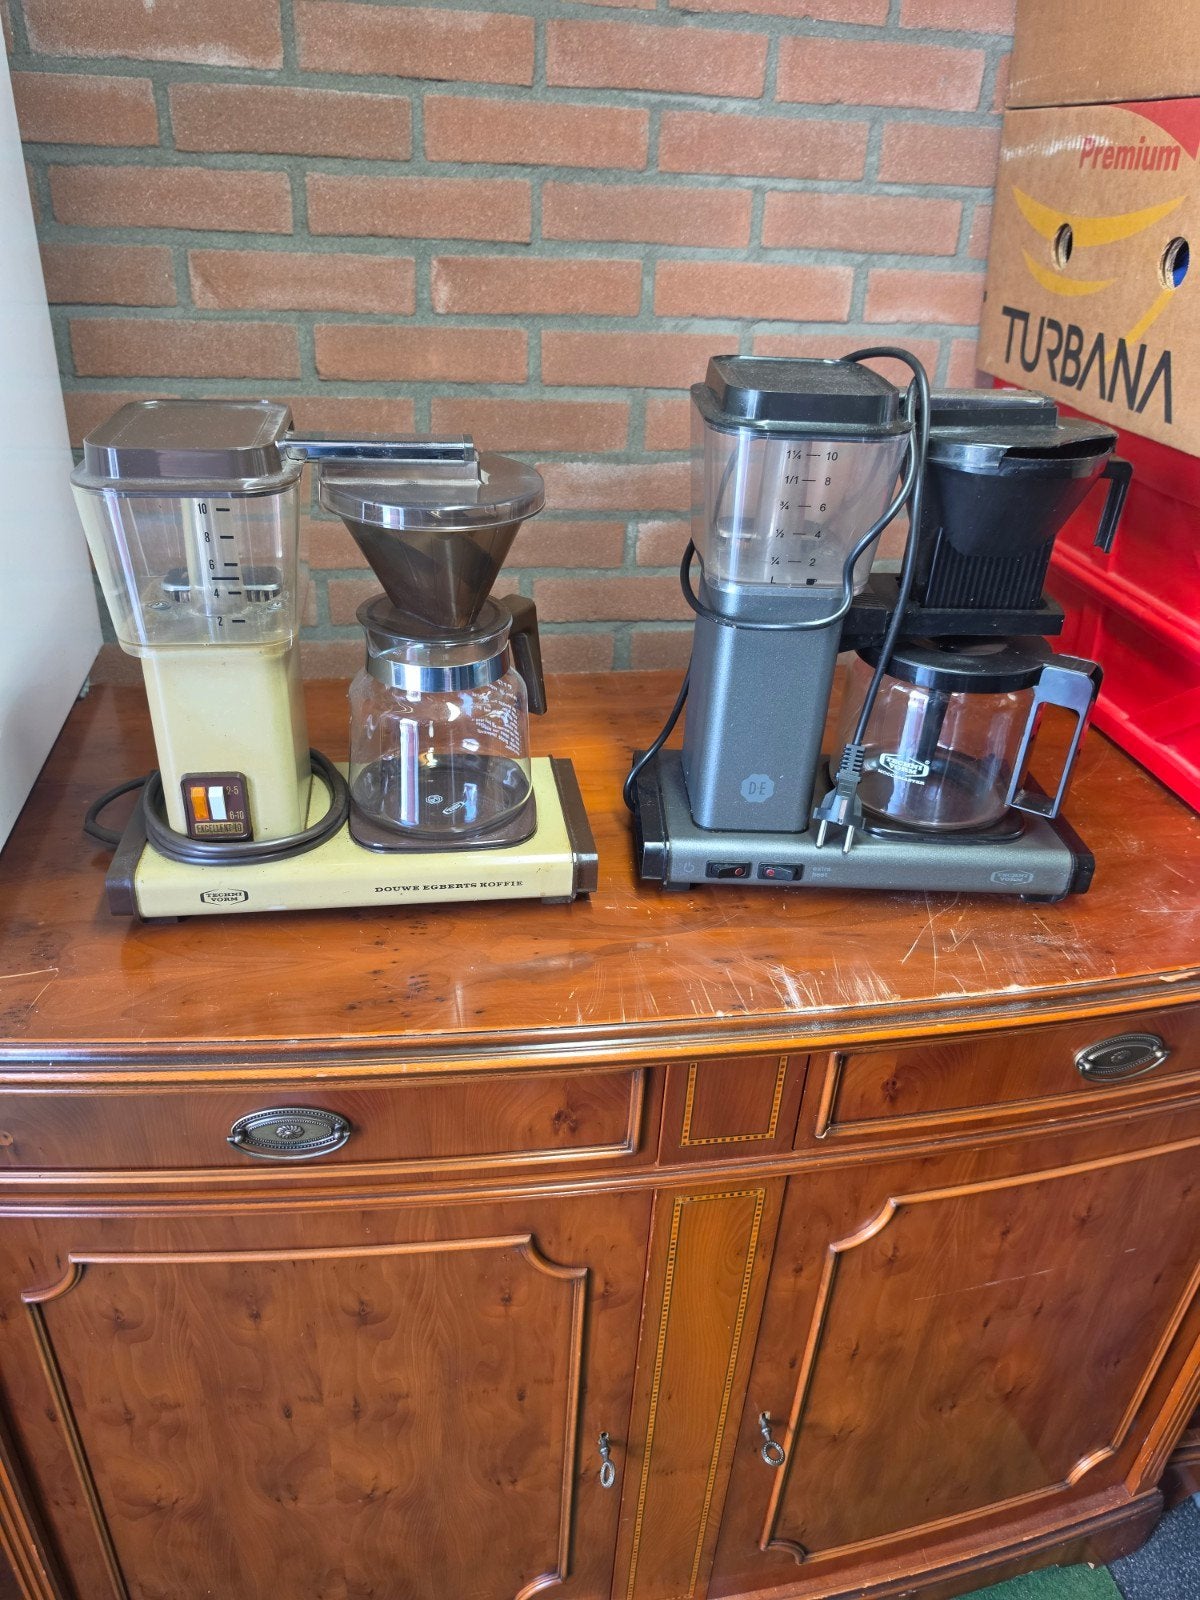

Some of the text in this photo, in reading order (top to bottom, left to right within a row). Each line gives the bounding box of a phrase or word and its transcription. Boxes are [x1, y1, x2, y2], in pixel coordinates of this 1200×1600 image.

[1079, 135, 1181, 172] Premium
[1001, 305, 1173, 425] TURBANA
[826, 451, 839, 461] 10
[824, 477, 831, 486] 8
[198, 503, 207, 514] 10
[820, 503, 827, 512] 6
[204, 532, 210, 543] 8
[815, 530, 821, 539] 4
[209, 560, 215, 570] 6
[809, 558, 816, 567] 2
[214, 588, 219, 599] 4
[218, 616, 223, 627] 2
[229, 810, 245, 820] 6-10
[374, 880, 523, 893] DOUWE EGBERTS KOFFIE
